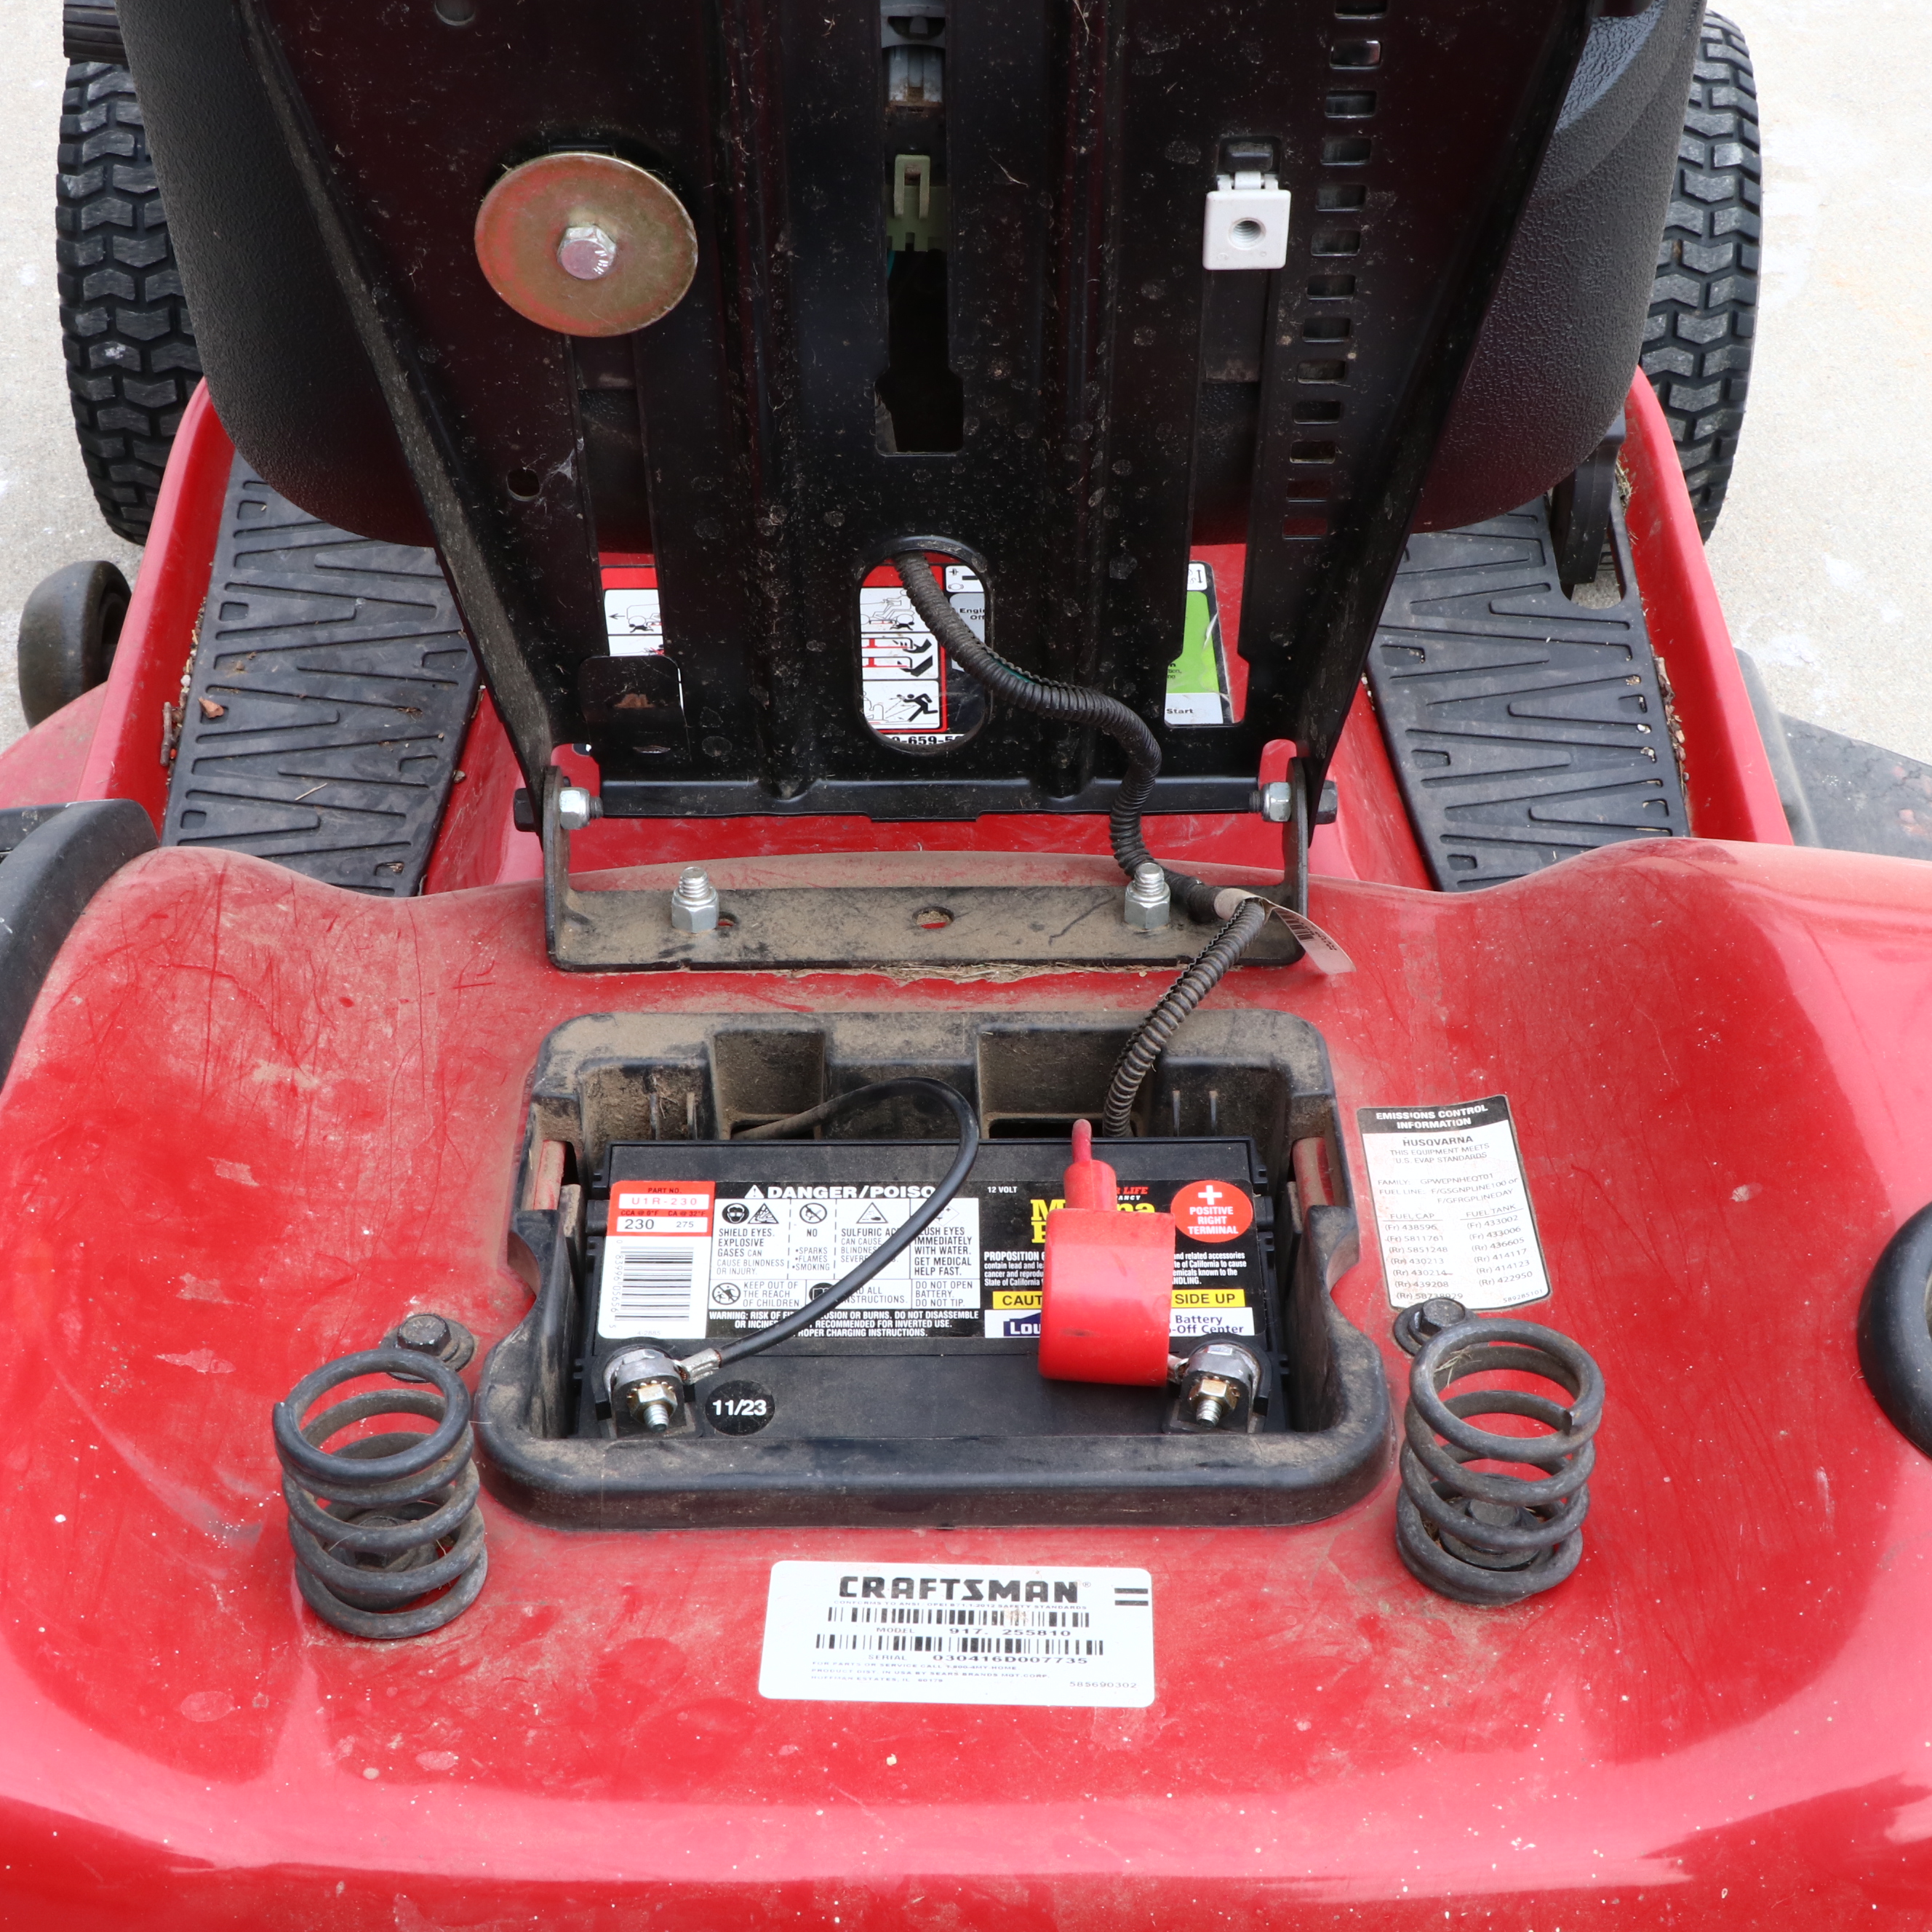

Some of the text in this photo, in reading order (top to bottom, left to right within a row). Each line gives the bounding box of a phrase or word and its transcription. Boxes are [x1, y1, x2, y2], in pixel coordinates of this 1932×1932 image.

[1376, 1104, 1489, 1120] EMISSIONS CONTROL
[1397, 1117, 1472, 1130] INFORMATION
[1402, 1135, 1474, 1146] HUSQVARNA
[1411, 1147, 1459, 1156] EQUIPMENT
[1461, 1143, 1490, 1152] MEETS
[1437, 1152, 1488, 1163] STANDARDS
[767, 1186, 936, 1199] DANGER/POISO
[987, 1186, 1018, 1194] 12 VOLT
[1123, 1186, 1149, 1194] LIFE
[1189, 1206, 1234, 1216] POSITIVE
[1466, 1204, 1517, 1218] FUEL TANK
[624, 1218, 655, 1229] 230
[1197, 1216, 1227, 1225] RIGHT
[1467, 1215, 1519, 1230] (Fr) 433002
[719, 1229, 775, 1237] SHIELD EYES.
[807, 1229, 818, 1237] NO
[841, 1228, 882, 1237] SULFURIC
[943, 1226, 965, 1236] EYES
[1187, 1226, 1239, 1234] TERMINAL
[1469, 1226, 1522, 1241] (Fr) 433006
[718, 1238, 765, 1247] EXPLOSIVE
[914, 1236, 973, 1245] IMMEDIATELY
[1490, 1237, 1525, 1249] 436605
[717, 1248, 744, 1257] GASES
[914, 1246, 972, 1255] WITH WATER.
[983, 1251, 1039, 1261] PROPOSITION
[1185, 1252, 1208, 1260] related
[1208, 1251, 1245, 1259] accessories
[1474, 1248, 1527, 1264] (Rr) 414117
[914, 1257, 972, 1266] GET MEDICAL
[1008, 1261, 1023, 1269] lead
[1023, 1261, 1035, 1269] and
[1181, 1260, 1188, 1268] of
[1189, 1260, 1220, 1268] California
[1220, 1260, 1227, 1268] to
[914, 1267, 962, 1276] HELP FAST.
[1476, 1259, 1530, 1275] (Rr) 414123
[1006, 1270, 1018, 1278] and
[1198, 1269, 1219, 1277] known
[1227, 1268, 1238, 1276] the
[984, 1278, 1040, 1287] State of California
[1479, 1271, 1533, 1287] (Rr) 422950
[743, 1281, 799, 1289] KEEP OUT OF
[916, 1281, 973, 1289] DO NOT OPEN
[743, 1290, 790, 1298] THE REACH
[867, 1286, 882, 1295] ALL
[916, 1290, 954, 1298] BATTERY.
[1002, 1293, 1236, 1306] CAUT SIDE UP
[1397, 1292, 1413, 1300] (Rr)
[743, 1298, 754, 1307] OF
[916, 1298, 965, 1307] DO NOT TIP.
[709, 1311, 979, 1320] WARNING: RISK OF OR BURNS. DO NOT DISASSEMBLE
[1175, 1314, 1223, 1325] Battery
[735, 1320, 952, 1329] OR RECOMMENDED FOR INVERTED USE.
[826, 1328, 928, 1337] CHARGING INSTRUCTIONS.
[1201, 1325, 1244, 1334] Center
[712, 1399, 767, 1416] 11/23
[1002, 1629, 1071, 1637] 255810
[933, 1655, 1088, 1664] 030416D007735
